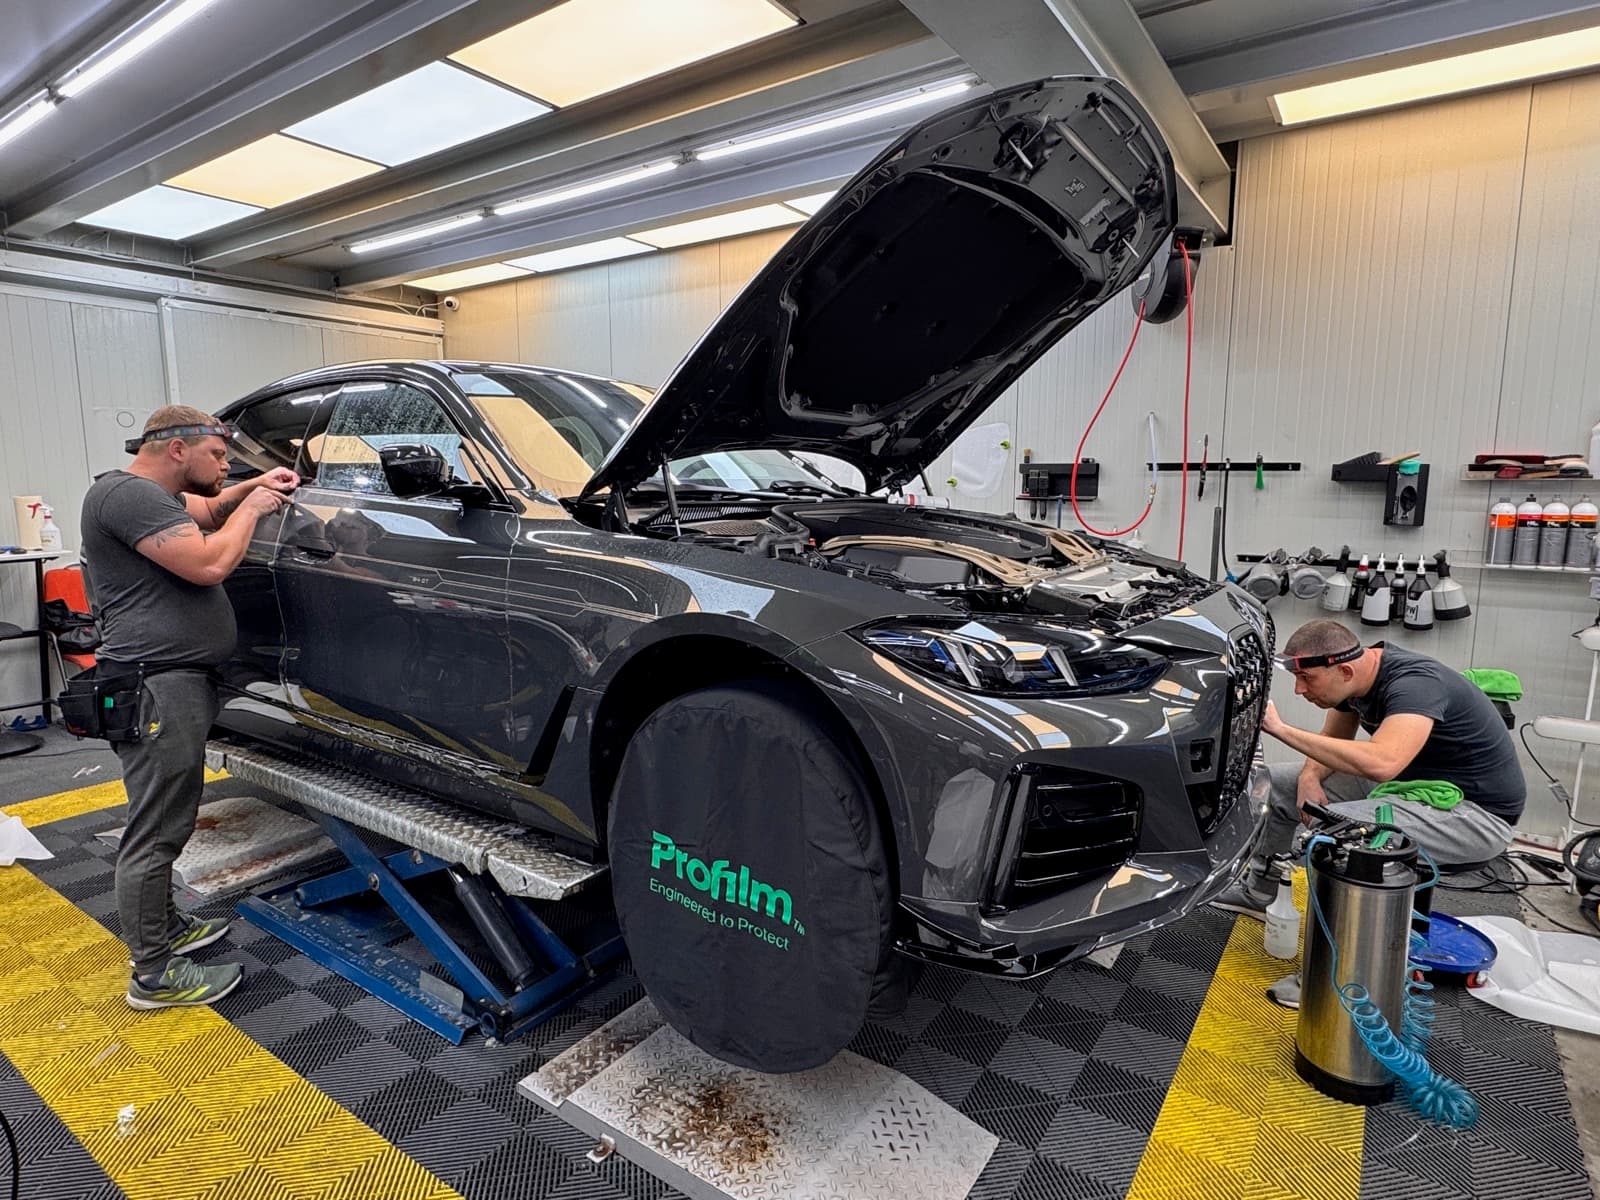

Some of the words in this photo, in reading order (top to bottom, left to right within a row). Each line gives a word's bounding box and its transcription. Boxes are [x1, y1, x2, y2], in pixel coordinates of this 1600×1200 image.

[650, 877, 717, 923] Engineered
[720, 913, 734, 929] to
[738, 917, 790, 951] Protect
[651, 830, 792, 925] Profilm
